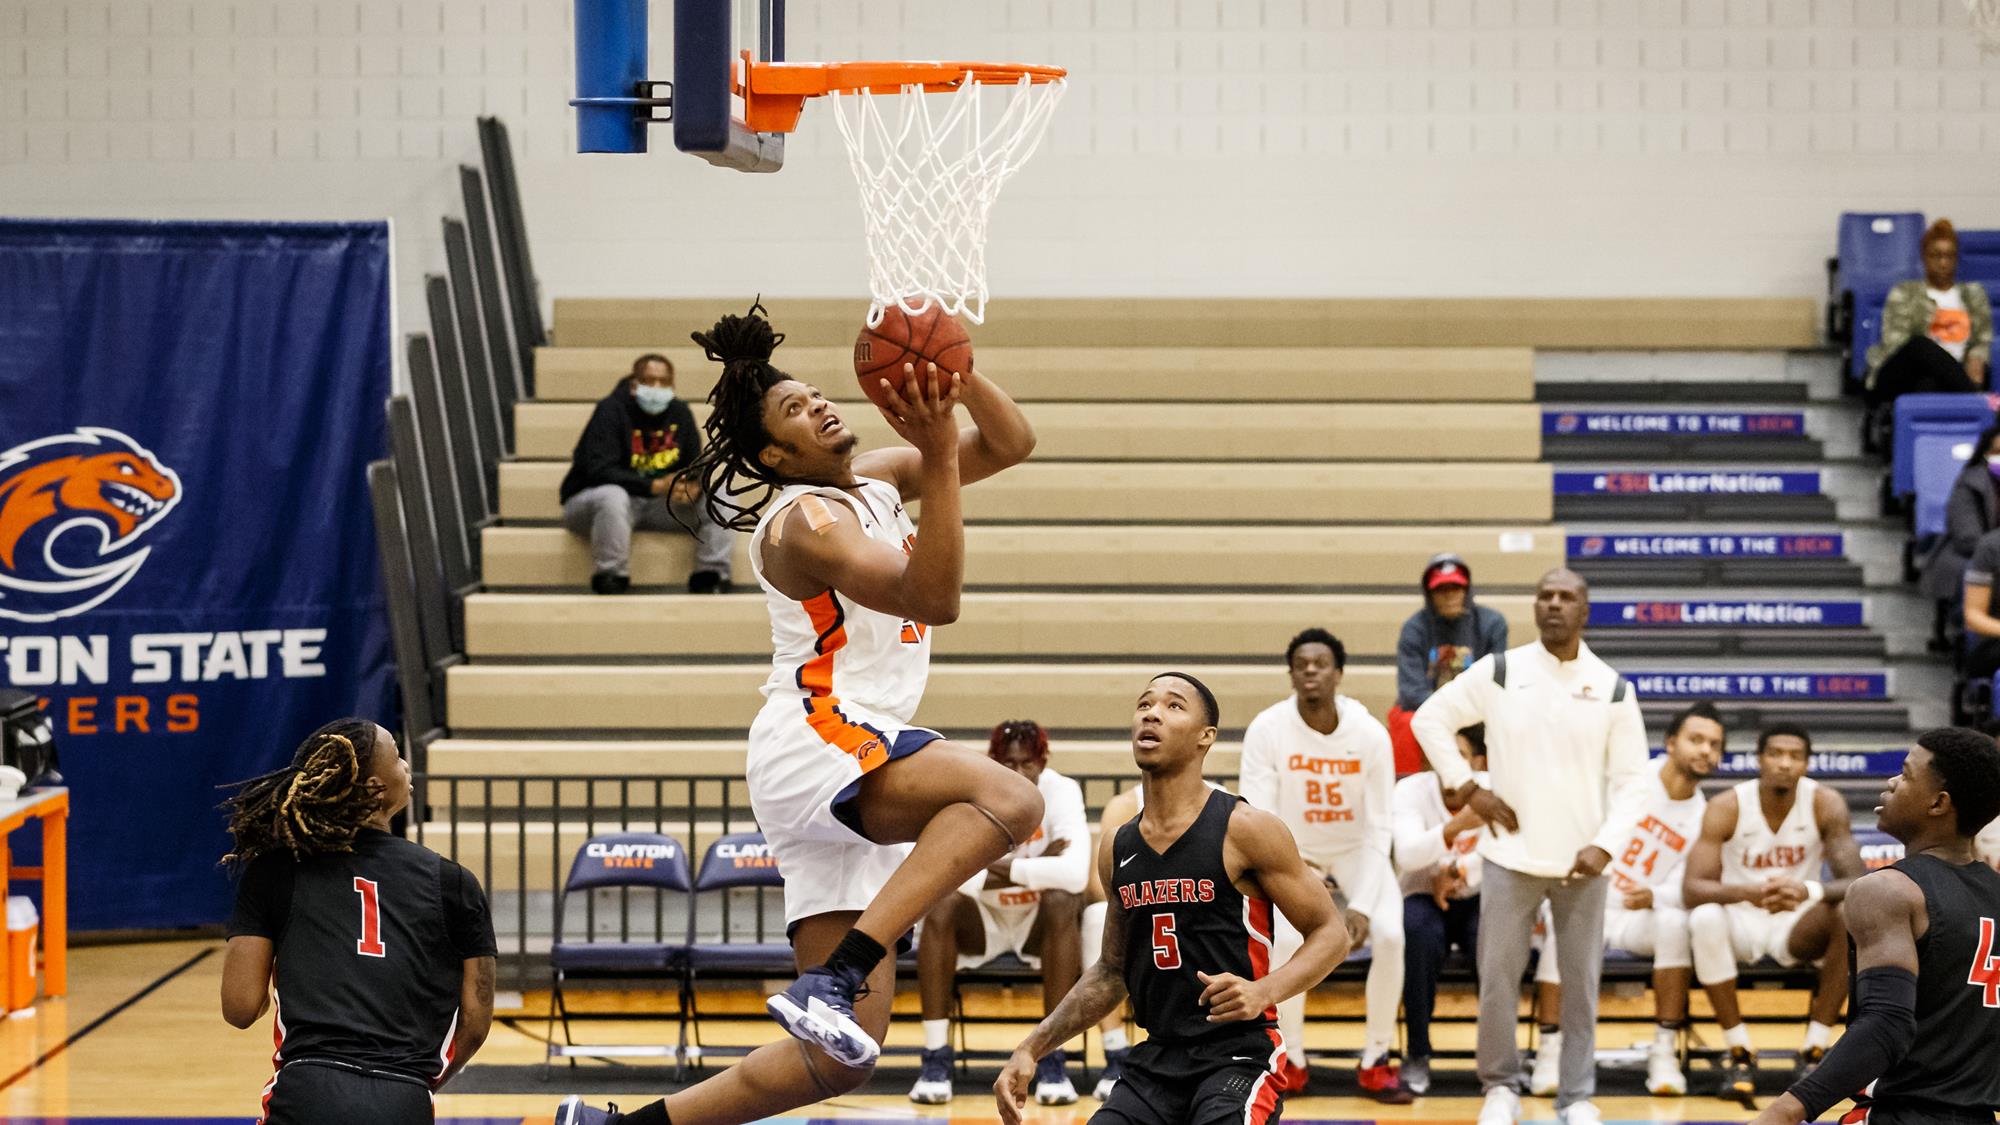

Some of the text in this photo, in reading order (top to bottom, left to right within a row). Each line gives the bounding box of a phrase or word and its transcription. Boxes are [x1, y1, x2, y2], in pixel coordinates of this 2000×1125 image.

[1587, 415, 1795, 431] WELCOME TO THE LOCH
[1594, 473, 1784, 492] #CSULakerNation
[1614, 537, 1833, 554] WELCOME TO THE LOCH
[1623, 603, 1823, 623] #CSULakerNation
[0, 628, 327, 685] ON STATE
[1637, 676, 1869, 694] WELCOME TO THE LOCH
[37, 694, 200, 735] ERS
[1288, 753, 1361, 775] CLAYTON
[587, 844, 675, 859] CLAYTON
[604, 856, 654, 869] STATE
[1621, 838, 1658, 877] 24
[1119, 879, 1215, 909] BLAZERS
[353, 876, 386, 958] 1
[1152, 912, 1182, 970] 5
[1967, 917, 2000, 1008] 4
